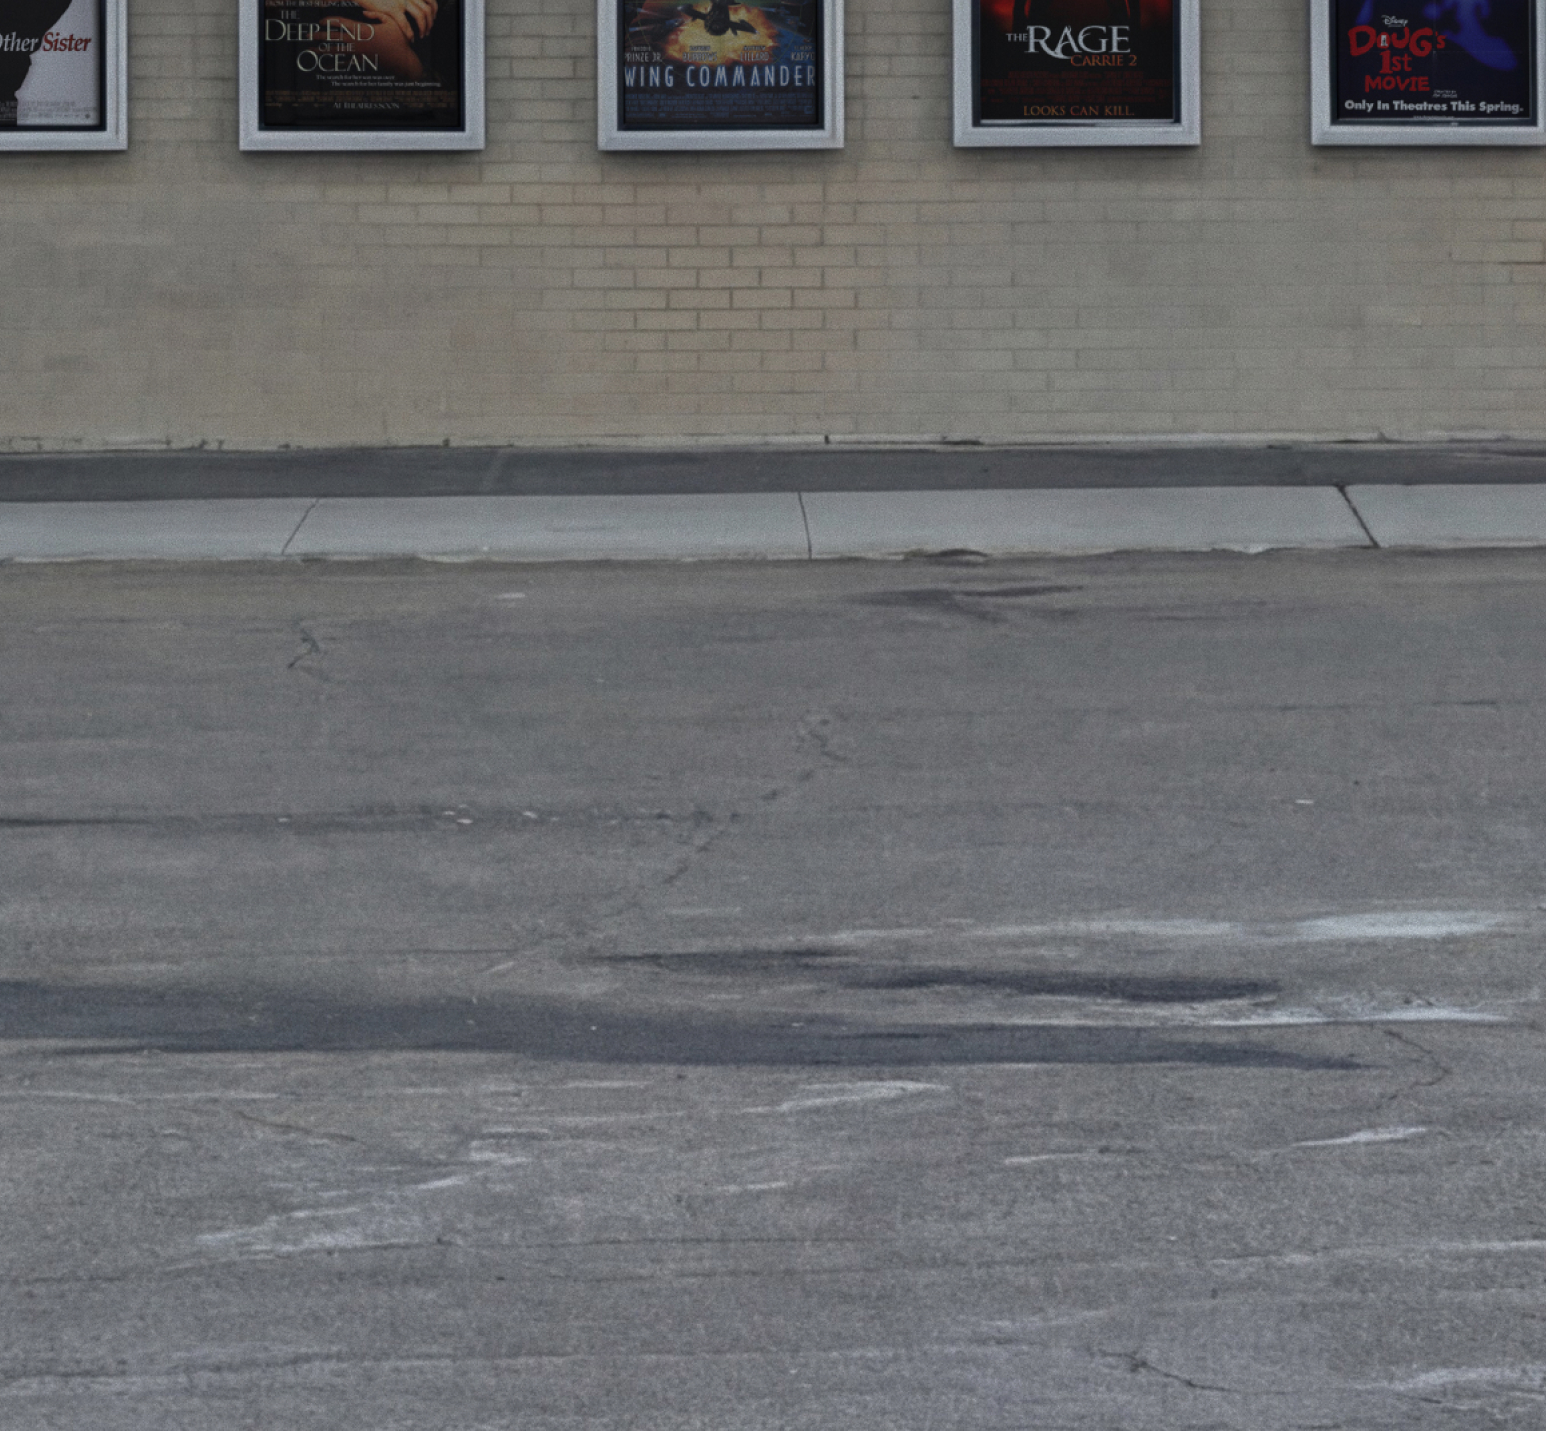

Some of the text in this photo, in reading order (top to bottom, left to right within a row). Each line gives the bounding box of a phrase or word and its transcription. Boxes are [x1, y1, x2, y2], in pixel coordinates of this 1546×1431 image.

[265, 19, 375, 41] DEEP END
[42, 31, 92, 52] Sister
[318, 43, 356, 52] OF THE
[1005, 25, 1131, 60] THE RAGE
[296, 50, 379, 72] OCEAN
[1070, 54, 1138, 67] CARRIE 2
[1379, 50, 1412, 74] 1st
[624, 65, 816, 87] WING COMMANDER
[1364, 75, 1430, 93] MOVIE
[1023, 105, 1135, 116] LOOKS CAN KILL.
[1344, 100, 1524, 114] Only In Theatres This Spring.
